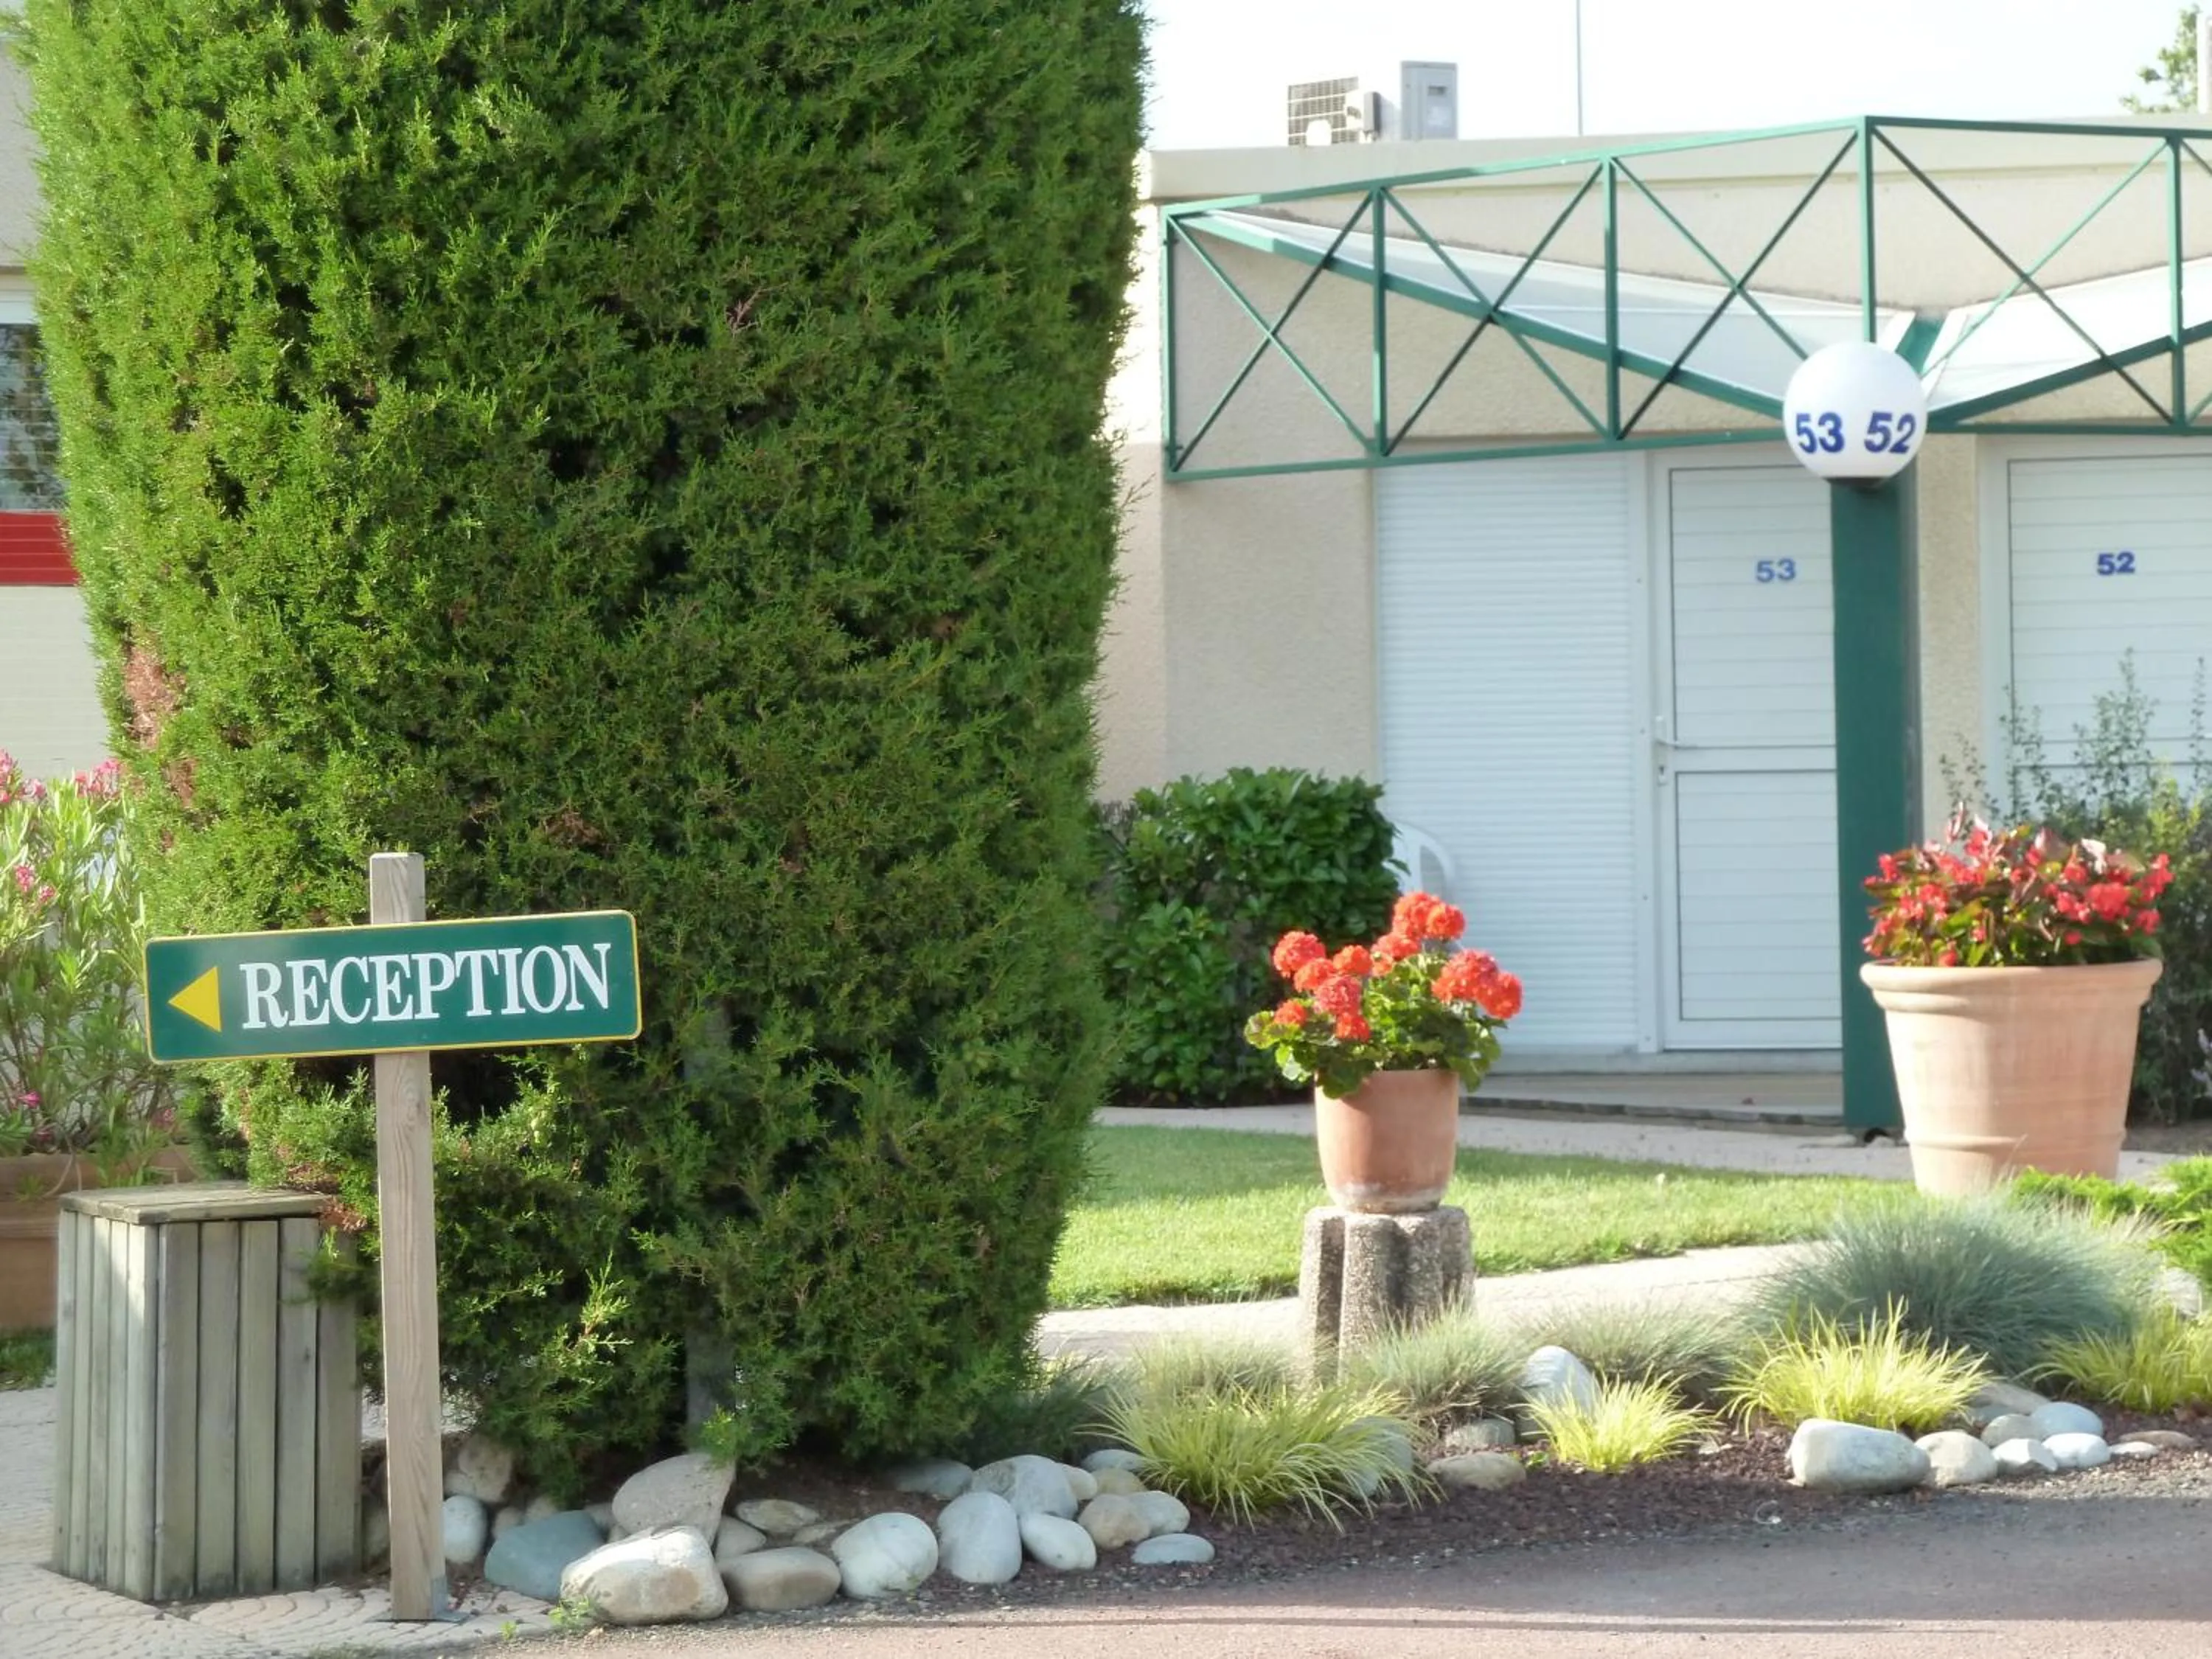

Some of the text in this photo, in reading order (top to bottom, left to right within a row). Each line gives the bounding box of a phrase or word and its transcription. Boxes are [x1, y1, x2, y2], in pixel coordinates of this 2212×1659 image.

[1795, 411, 1916, 454] 53 52
[1756, 558, 1796, 582] 53
[2097, 552, 2136, 575] 52
[239, 943, 611, 1029] RECEPTION
